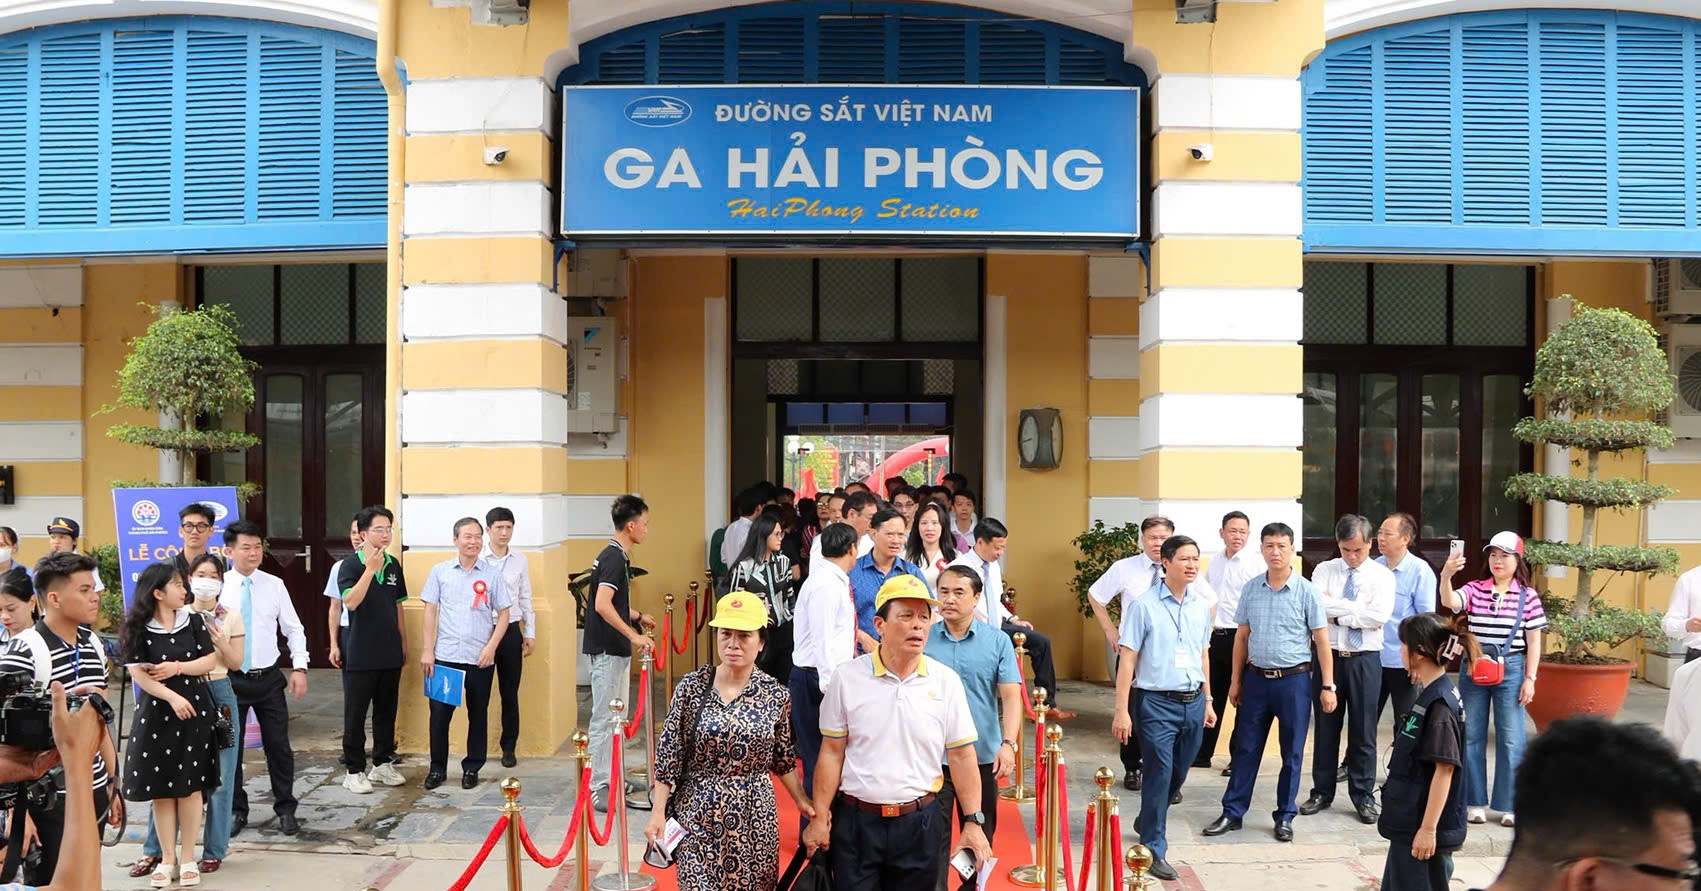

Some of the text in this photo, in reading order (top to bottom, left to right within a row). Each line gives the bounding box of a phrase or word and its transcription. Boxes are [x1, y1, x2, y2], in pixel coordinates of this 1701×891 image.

[715, 95, 993, 127] ĐƯỜNG SẮT VIỆT NAM
[603, 131, 1104, 191] GA HẢI PHÒNG
[727, 196, 979, 222] HaiPhong Station
[128, 543, 150, 561] LỄ
